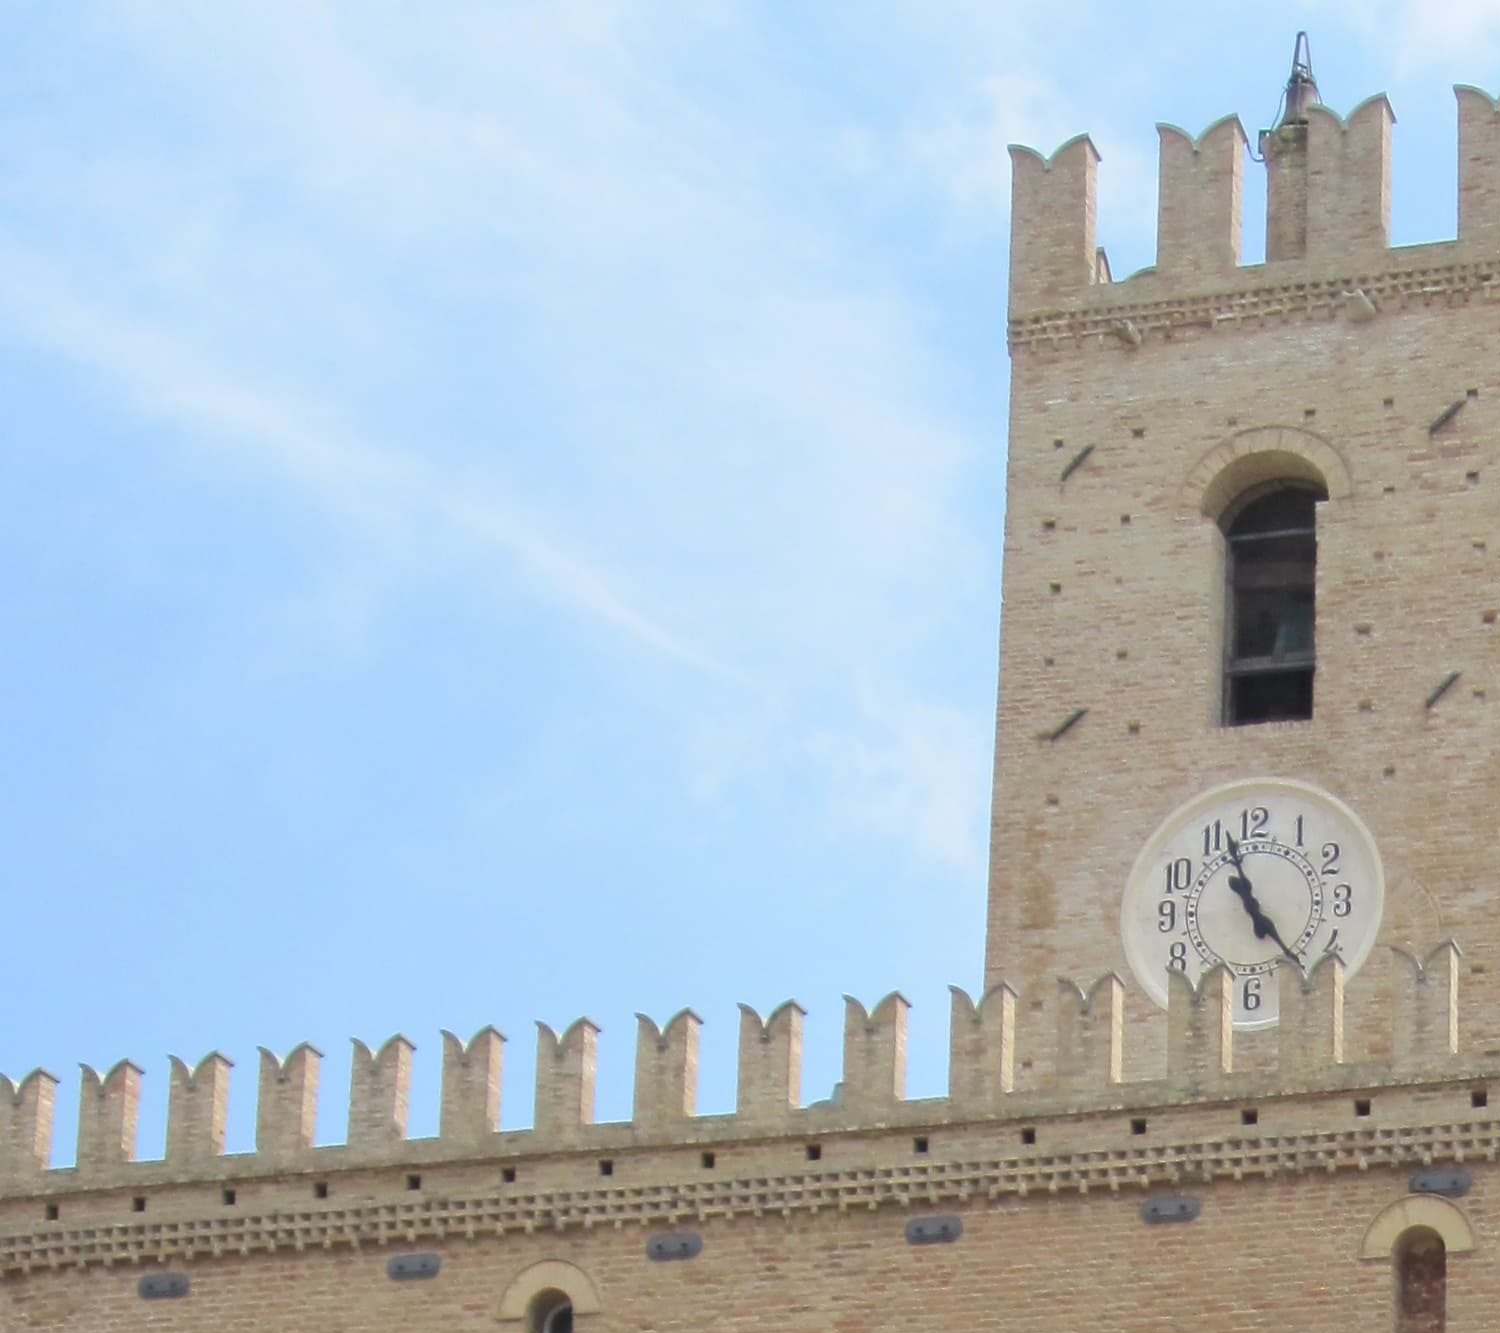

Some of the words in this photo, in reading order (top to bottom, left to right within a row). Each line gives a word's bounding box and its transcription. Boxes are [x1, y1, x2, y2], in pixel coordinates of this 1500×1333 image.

[1202, 819, 1222, 857] 11
[1239, 807, 1269, 841] 12
[1295, 815, 1304, 846] 1
[1321, 843, 1340, 875] 2
[1164, 858, 1192, 894] 10
[1158, 900, 1176, 933] 9
[1333, 884, 1352, 917] 3
[1169, 942, 1187, 971] 8
[1243, 977, 1260, 1010] 6
